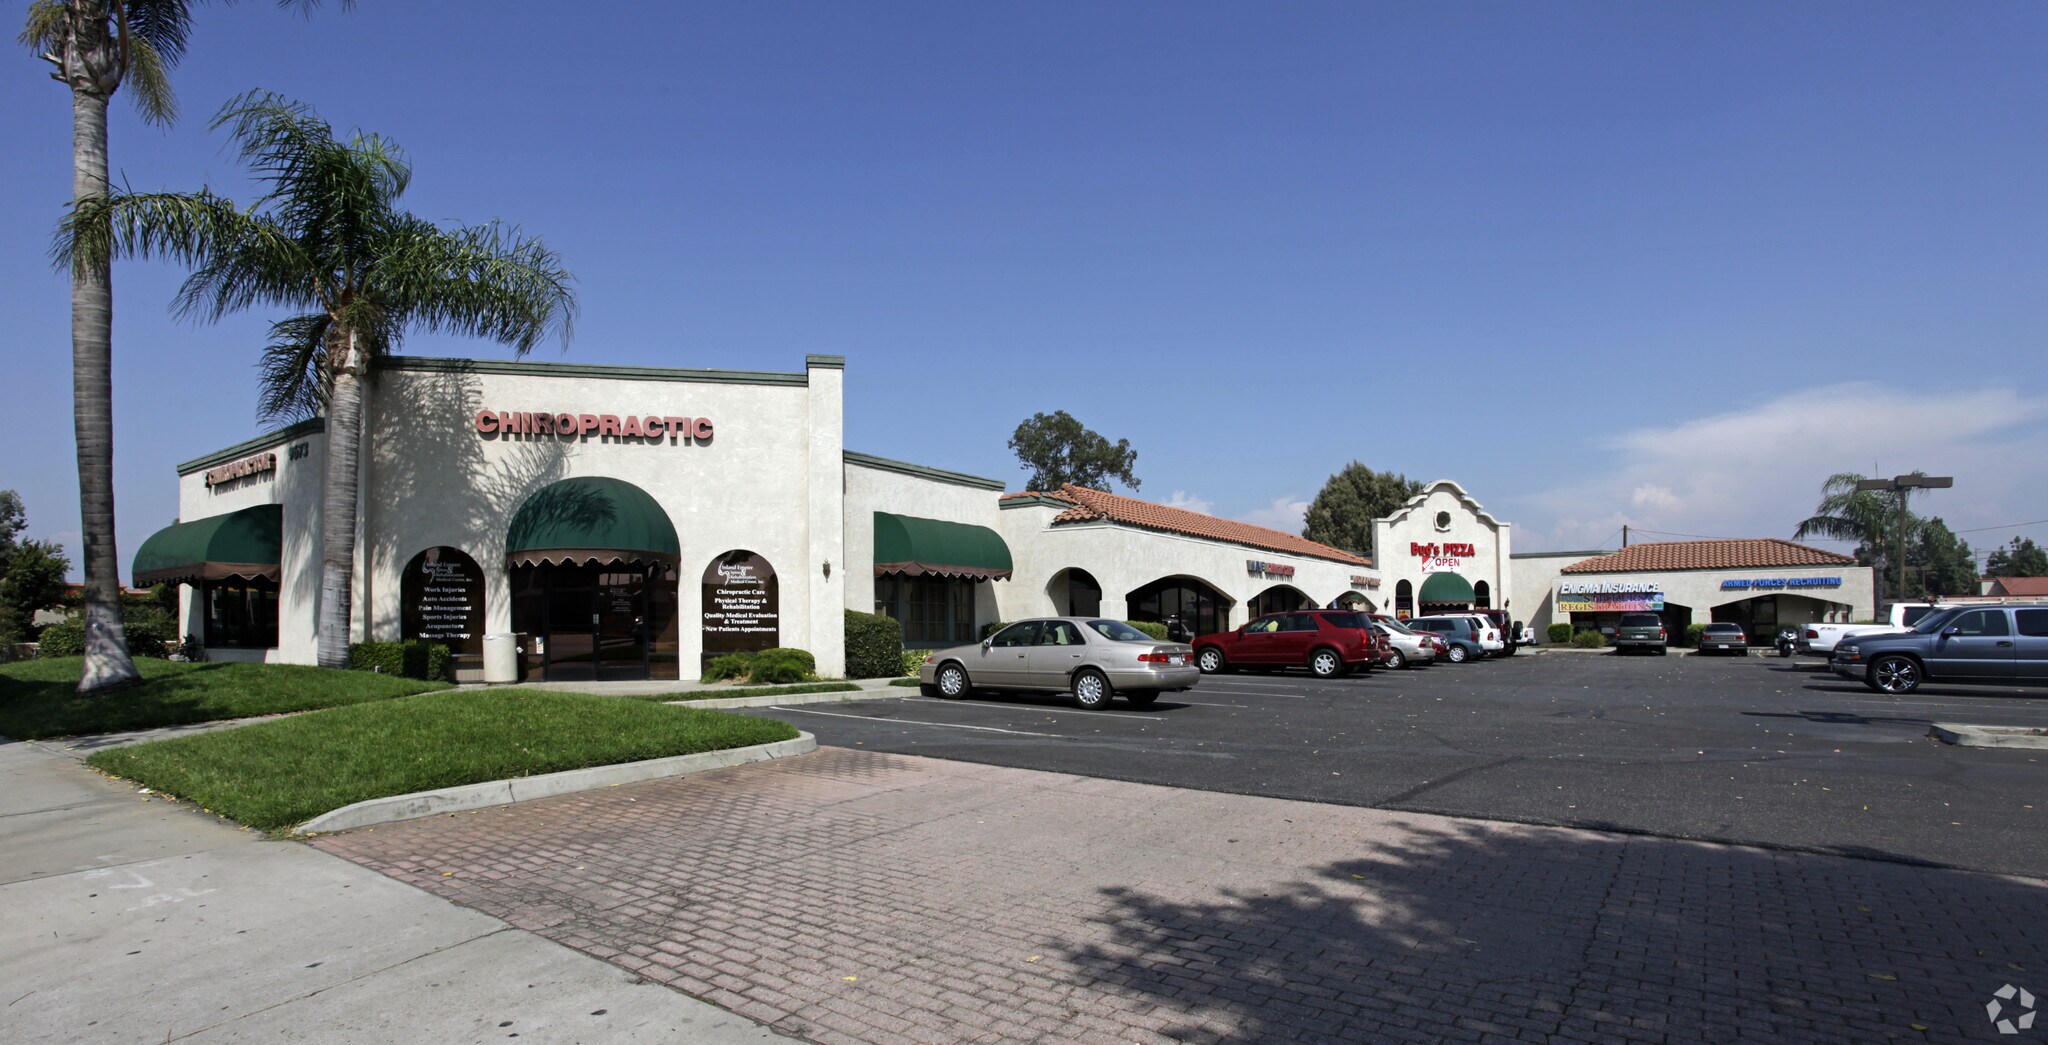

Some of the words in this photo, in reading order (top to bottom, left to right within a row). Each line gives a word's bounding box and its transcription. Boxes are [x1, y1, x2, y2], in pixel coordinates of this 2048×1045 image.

[476, 410, 714, 440] CHIROPRACTIC
[1411, 542, 1440, 556] Bud's
[1443, 543, 1475, 557] PIZZA
[1435, 558, 1460, 567] OPEN
[1723, 580, 1752, 588] ARMED
[1754, 579, 1787, 587] FORCES
[1789, 577, 1842, 586] RECRUITING
